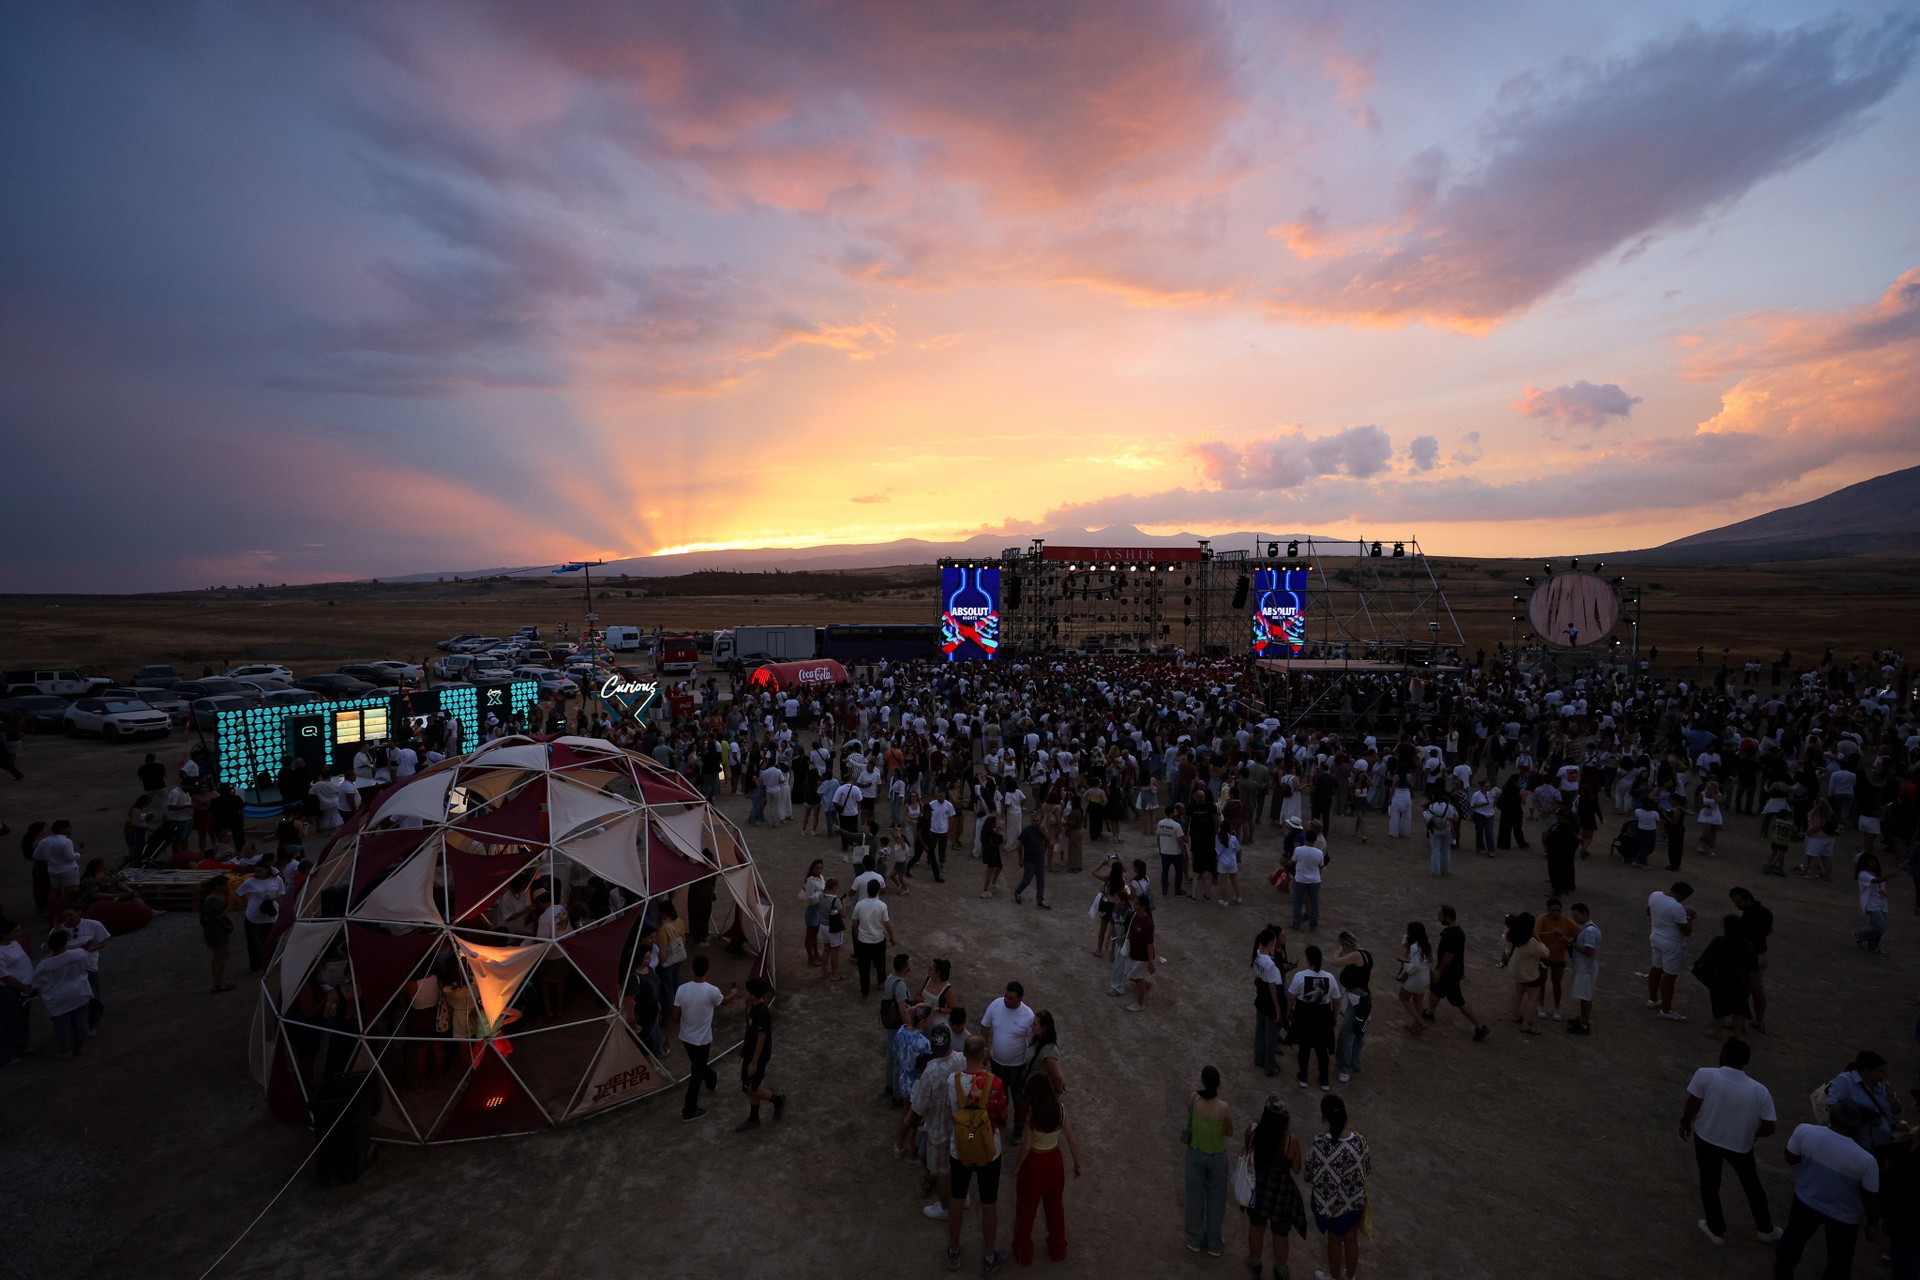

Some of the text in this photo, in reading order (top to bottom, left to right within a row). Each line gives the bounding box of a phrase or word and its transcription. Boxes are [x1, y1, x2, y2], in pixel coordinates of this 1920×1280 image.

[1092, 549, 1154, 560] TASHIR
[951, 607, 989, 616] ABSOLUT
[1262, 607, 1296, 616] ABSOLUT
[799, 666, 833, 683] Coca-Cola
[601, 675, 658, 698] Curious
[592, 1072, 650, 1103] SETTER
[594, 1065, 648, 1094] TREND
